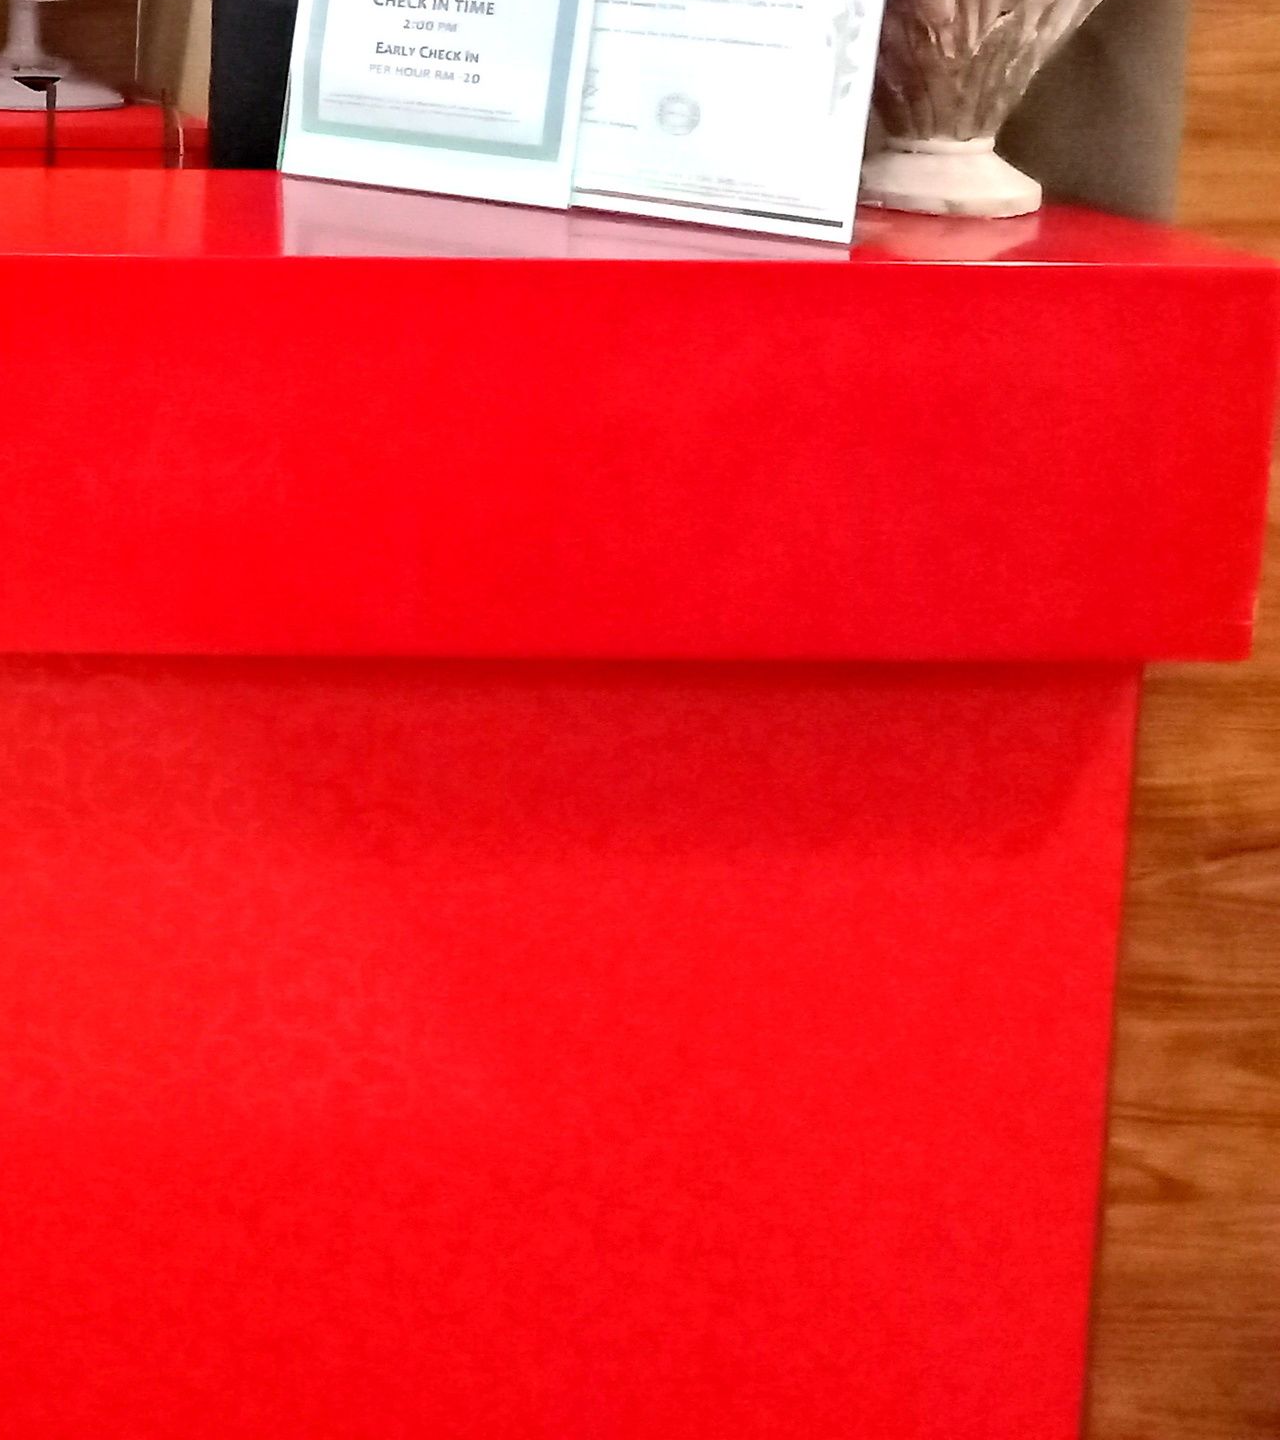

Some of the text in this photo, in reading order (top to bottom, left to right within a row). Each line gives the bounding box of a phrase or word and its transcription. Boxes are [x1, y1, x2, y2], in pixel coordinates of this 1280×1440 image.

[454, 0, 496, 16] TIME
[369, 63, 391, 75] PER
[395, 66, 432, 79] HOUR
[434, 69, 455, 82] RM
